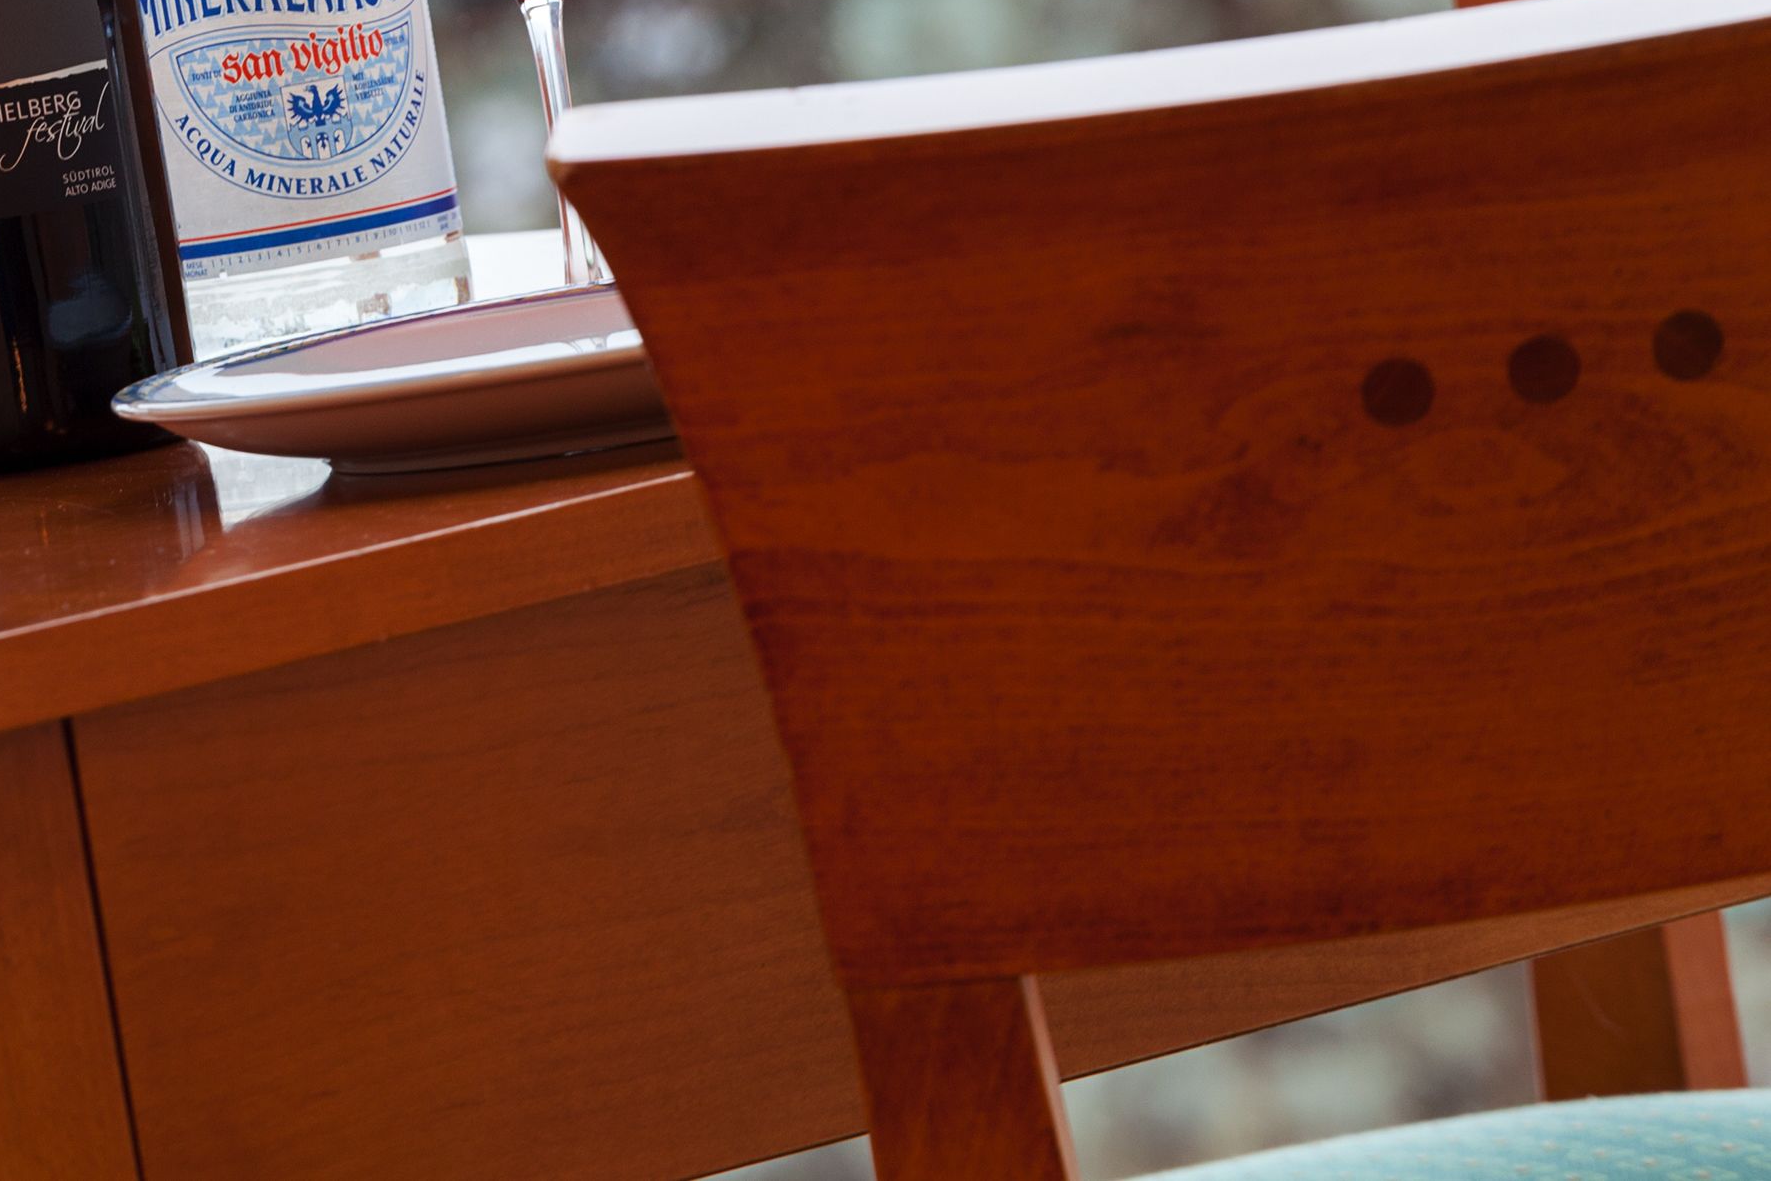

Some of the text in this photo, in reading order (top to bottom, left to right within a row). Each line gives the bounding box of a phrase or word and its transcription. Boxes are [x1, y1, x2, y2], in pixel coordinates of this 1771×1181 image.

[222, 23, 383, 84] san vigilio
[175, 69, 425, 195] ACQUA MINERALE NATURALE
[62, 165, 115, 185] SÜDTIROL
[65, 177, 117, 197] ALTO ADIGE
